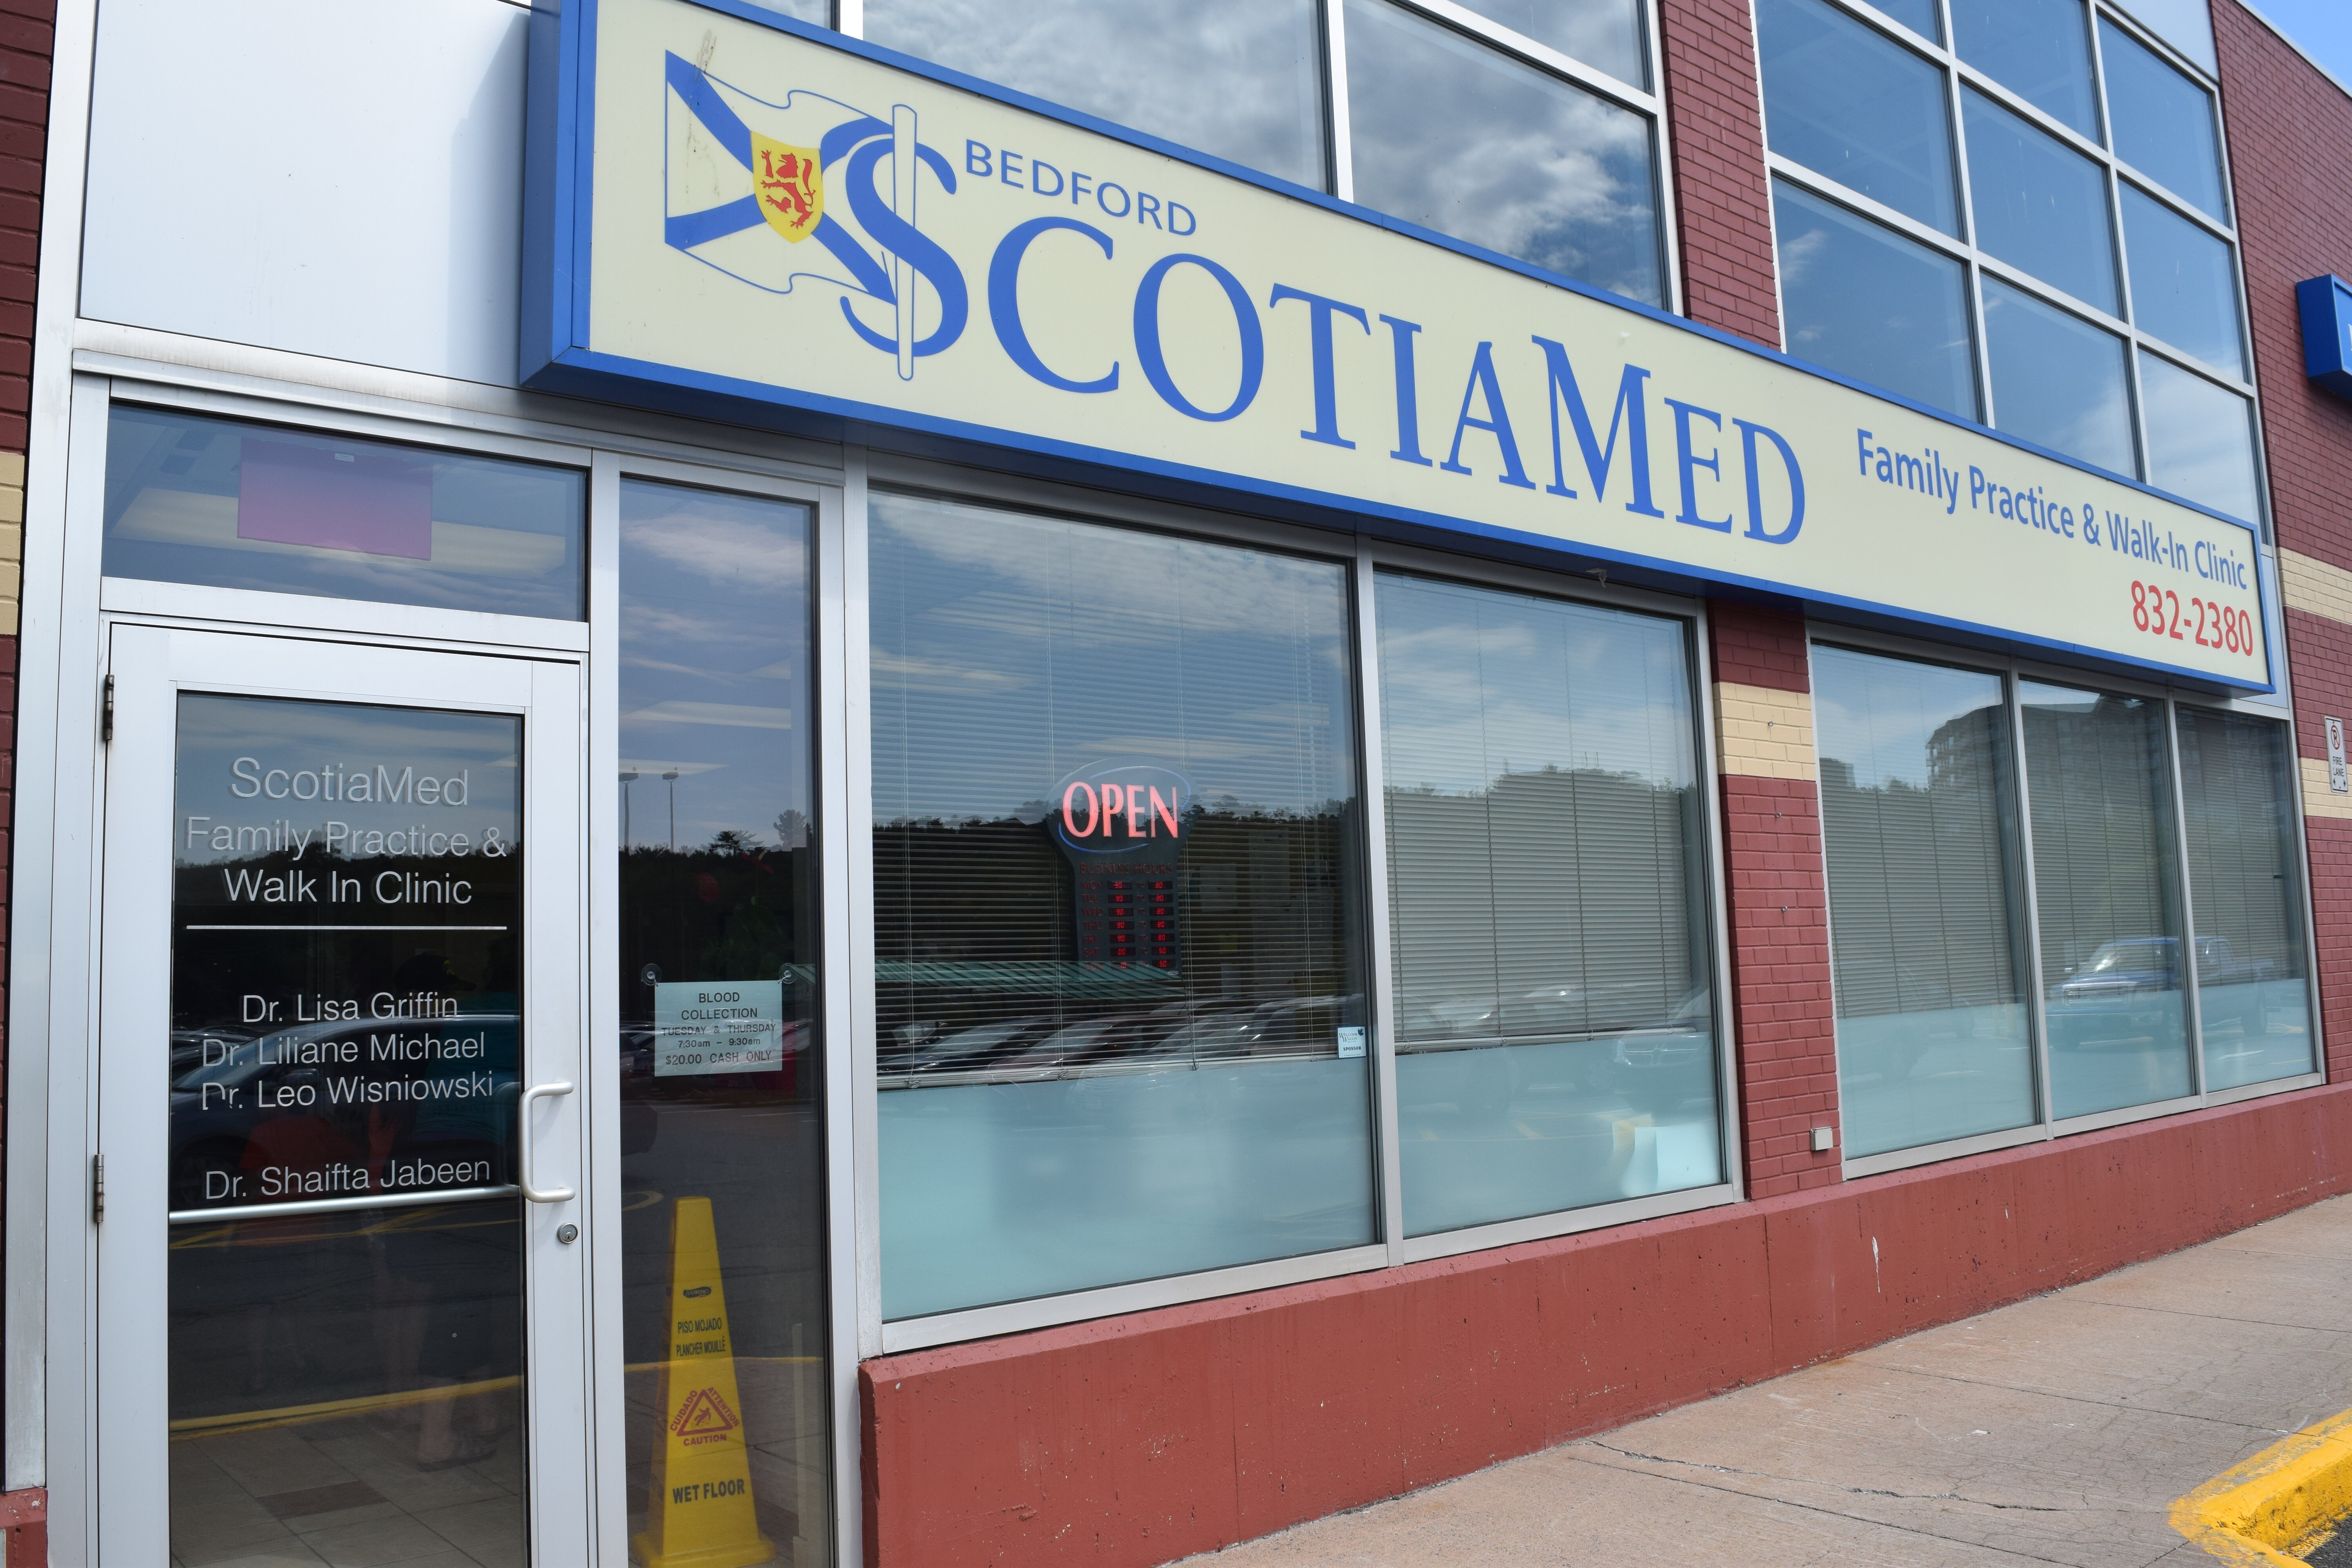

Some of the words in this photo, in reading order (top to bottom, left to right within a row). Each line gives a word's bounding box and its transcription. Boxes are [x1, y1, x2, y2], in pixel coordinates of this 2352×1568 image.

[966, 138, 1197, 237] BEDFORD
[840, 137, 1805, 545] SCOTIAMED
[1857, 428, 1959, 514] Family
[1969, 465, 2074, 539] Practice
[2083, 503, 2102, 546] &
[2105, 510, 2189, 573] Walk-In
[2194, 540, 2248, 590] Clinic
[2131, 580, 2253, 657] 832-2380
[2332, 756, 2343, 766] FIRE
[2333, 768, 2344, 777] LANE
[231, 757, 468, 806] ScotiaMed
[1062, 781, 1178, 838] OPEN
[187, 816, 312, 861] Family
[326, 821, 470, 857] Practice
[483, 827, 507, 858] &
[1079, 862, 1130, 874] BUSINESS
[1133, 862, 1173, 874] HOURS
[224, 868, 317, 902] Walk
[332, 870, 361, 902] In
[375, 871, 472, 904] Clinic
[1081, 880, 1103, 889] MON
[1082, 894, 1098, 903] TUE
[1082, 907, 1104, 916] WED
[1082, 921, 1102, 930] THU
[1083, 934, 1097, 943] FRI
[1084, 947, 1100, 957] SAT
[1084, 961, 1103, 971] SUN
[699, 992, 740, 1004] BLOOD
[243, 994, 283, 1022] Dr.
[298, 993, 360, 1021] Lisa
[370, 992, 458, 1019] Griffin
[681, 1007, 758, 1020] COLLECTION
[661, 1025, 707, 1036] TUESDAY
[713, 1025, 720, 1034] &
[727, 1023, 776, 1034] THURSDAY
[203, 1038, 243, 1067] Dr.
[258, 1036, 358, 1065] Liliane
[370, 1031, 485, 1061] Michael
[678, 1040, 710, 1048] 7:30am
[729, 1038, 760, 1046] 9:30am
[666, 1054, 702, 1065] $20.00
[710, 1052, 739, 1063] CASH
[746, 1050, 772, 1062] ONLY
[202, 1082, 243, 1110] Dr.
[258, 1080, 316, 1108] Leo
[326, 1071, 493, 1104] Wisniowski
[206, 1171, 247, 1200] Dr.
[261, 1163, 370, 1196] Shaifta
[380, 1158, 490, 1187] Jabeen
[677, 1321, 693, 1334] PISO
[695, 1317, 722, 1332] MOJADO
[676, 1342, 703, 1357] PLANCHER
[704, 1336, 726, 1353] MOUILLÉ
[670, 1390, 698, 1431] CUIDADO
[707, 1387, 740, 1427] ATTENTION
[683, 1433, 727, 1446] CAUTION
[672, 1484, 700, 1504] WET
[703, 1478, 746, 1499] FLOOR
